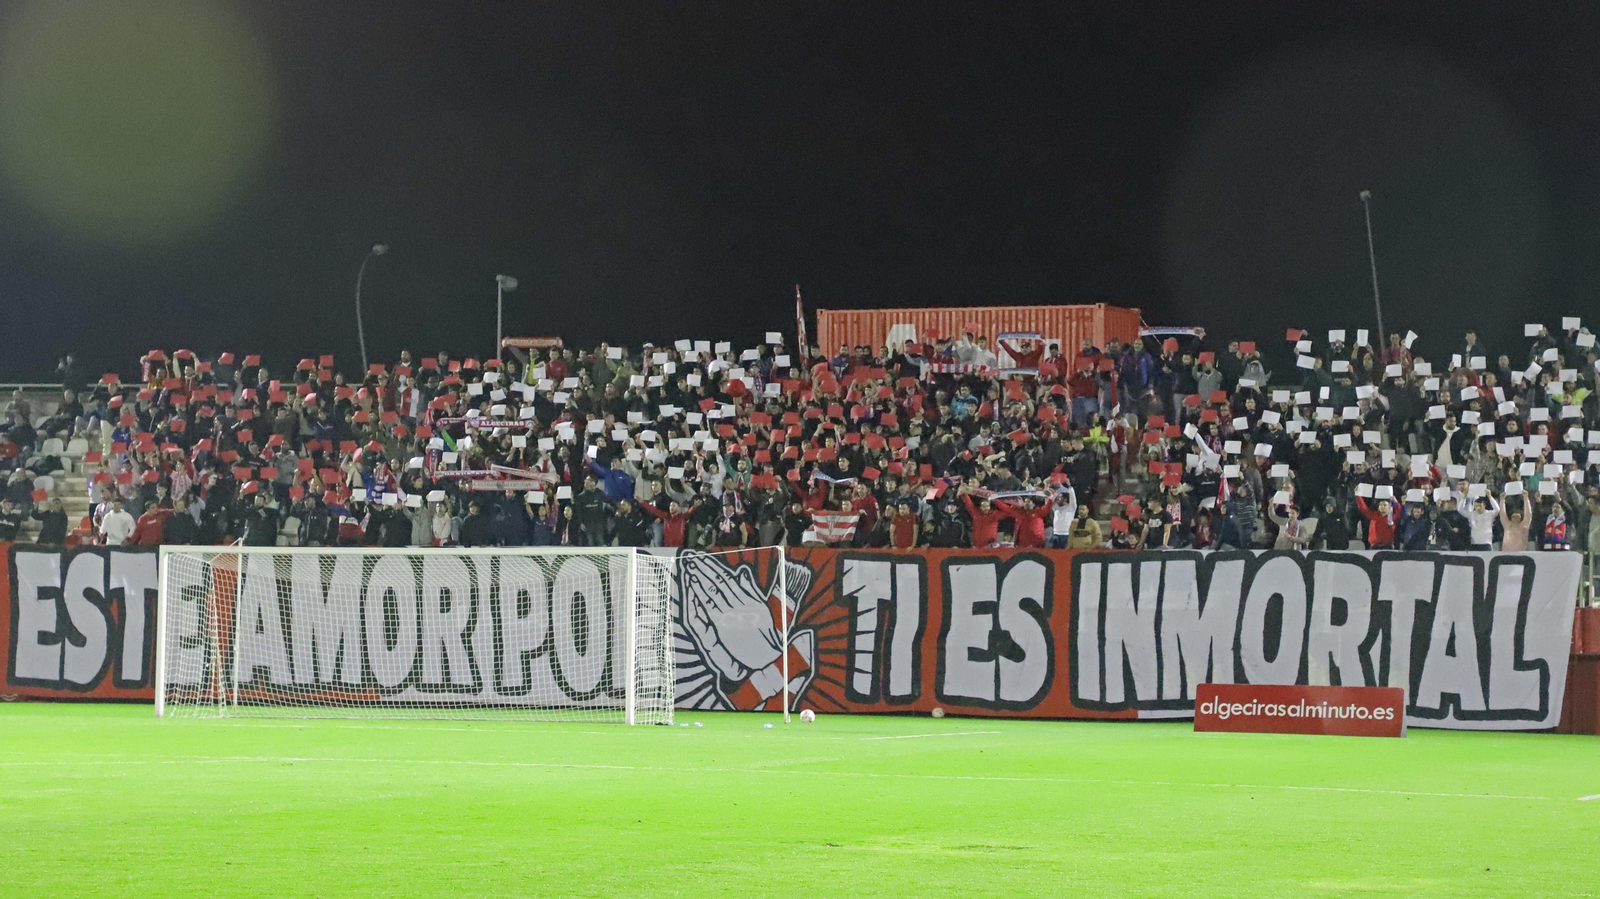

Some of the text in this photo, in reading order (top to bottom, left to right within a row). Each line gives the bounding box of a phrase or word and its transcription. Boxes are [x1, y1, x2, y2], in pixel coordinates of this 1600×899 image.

[12, 548, 207, 688] ESTE
[236, 553, 480, 694] AMOR
[841, 555, 923, 701] TI
[939, 555, 1053, 707] ES
[1073, 551, 1546, 717] INMORTAL
[1200, 696, 1395, 721] algecirasalminuto.es
